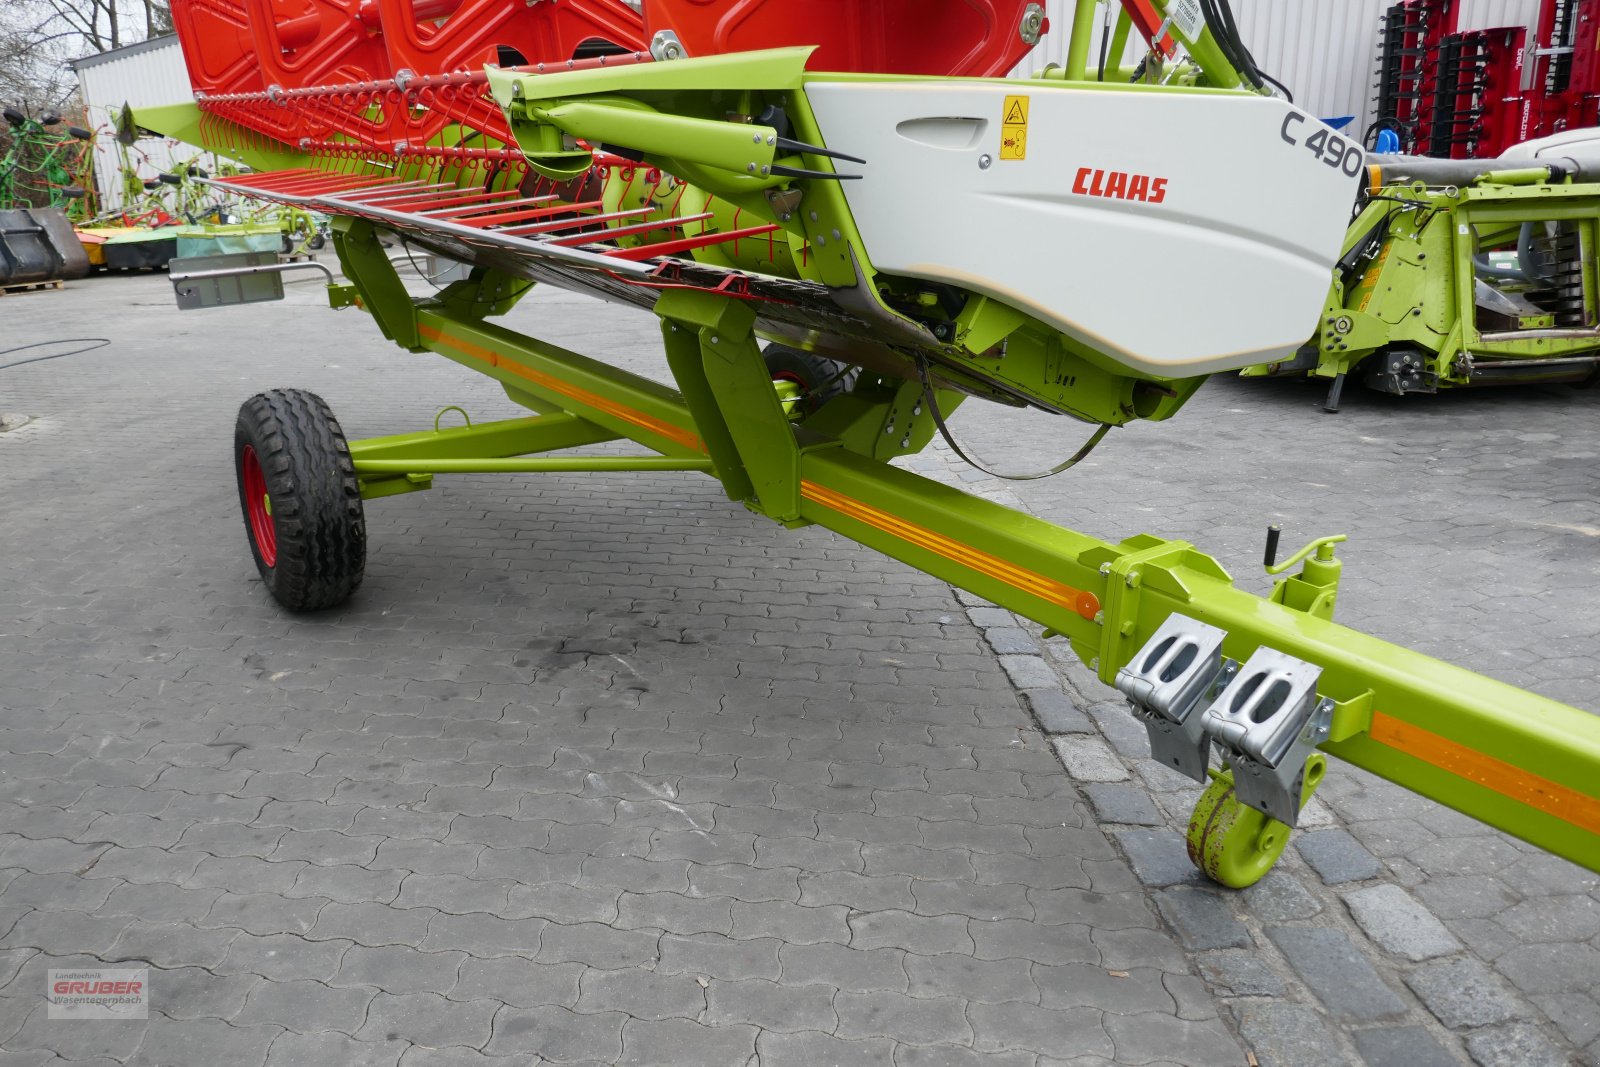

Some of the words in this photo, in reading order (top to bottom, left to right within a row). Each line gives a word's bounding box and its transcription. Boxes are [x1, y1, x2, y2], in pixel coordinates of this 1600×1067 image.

[1281, 111, 1305, 146] C
[1305, 129, 1363, 178] 490
[1072, 167, 1168, 203] CLAAS
